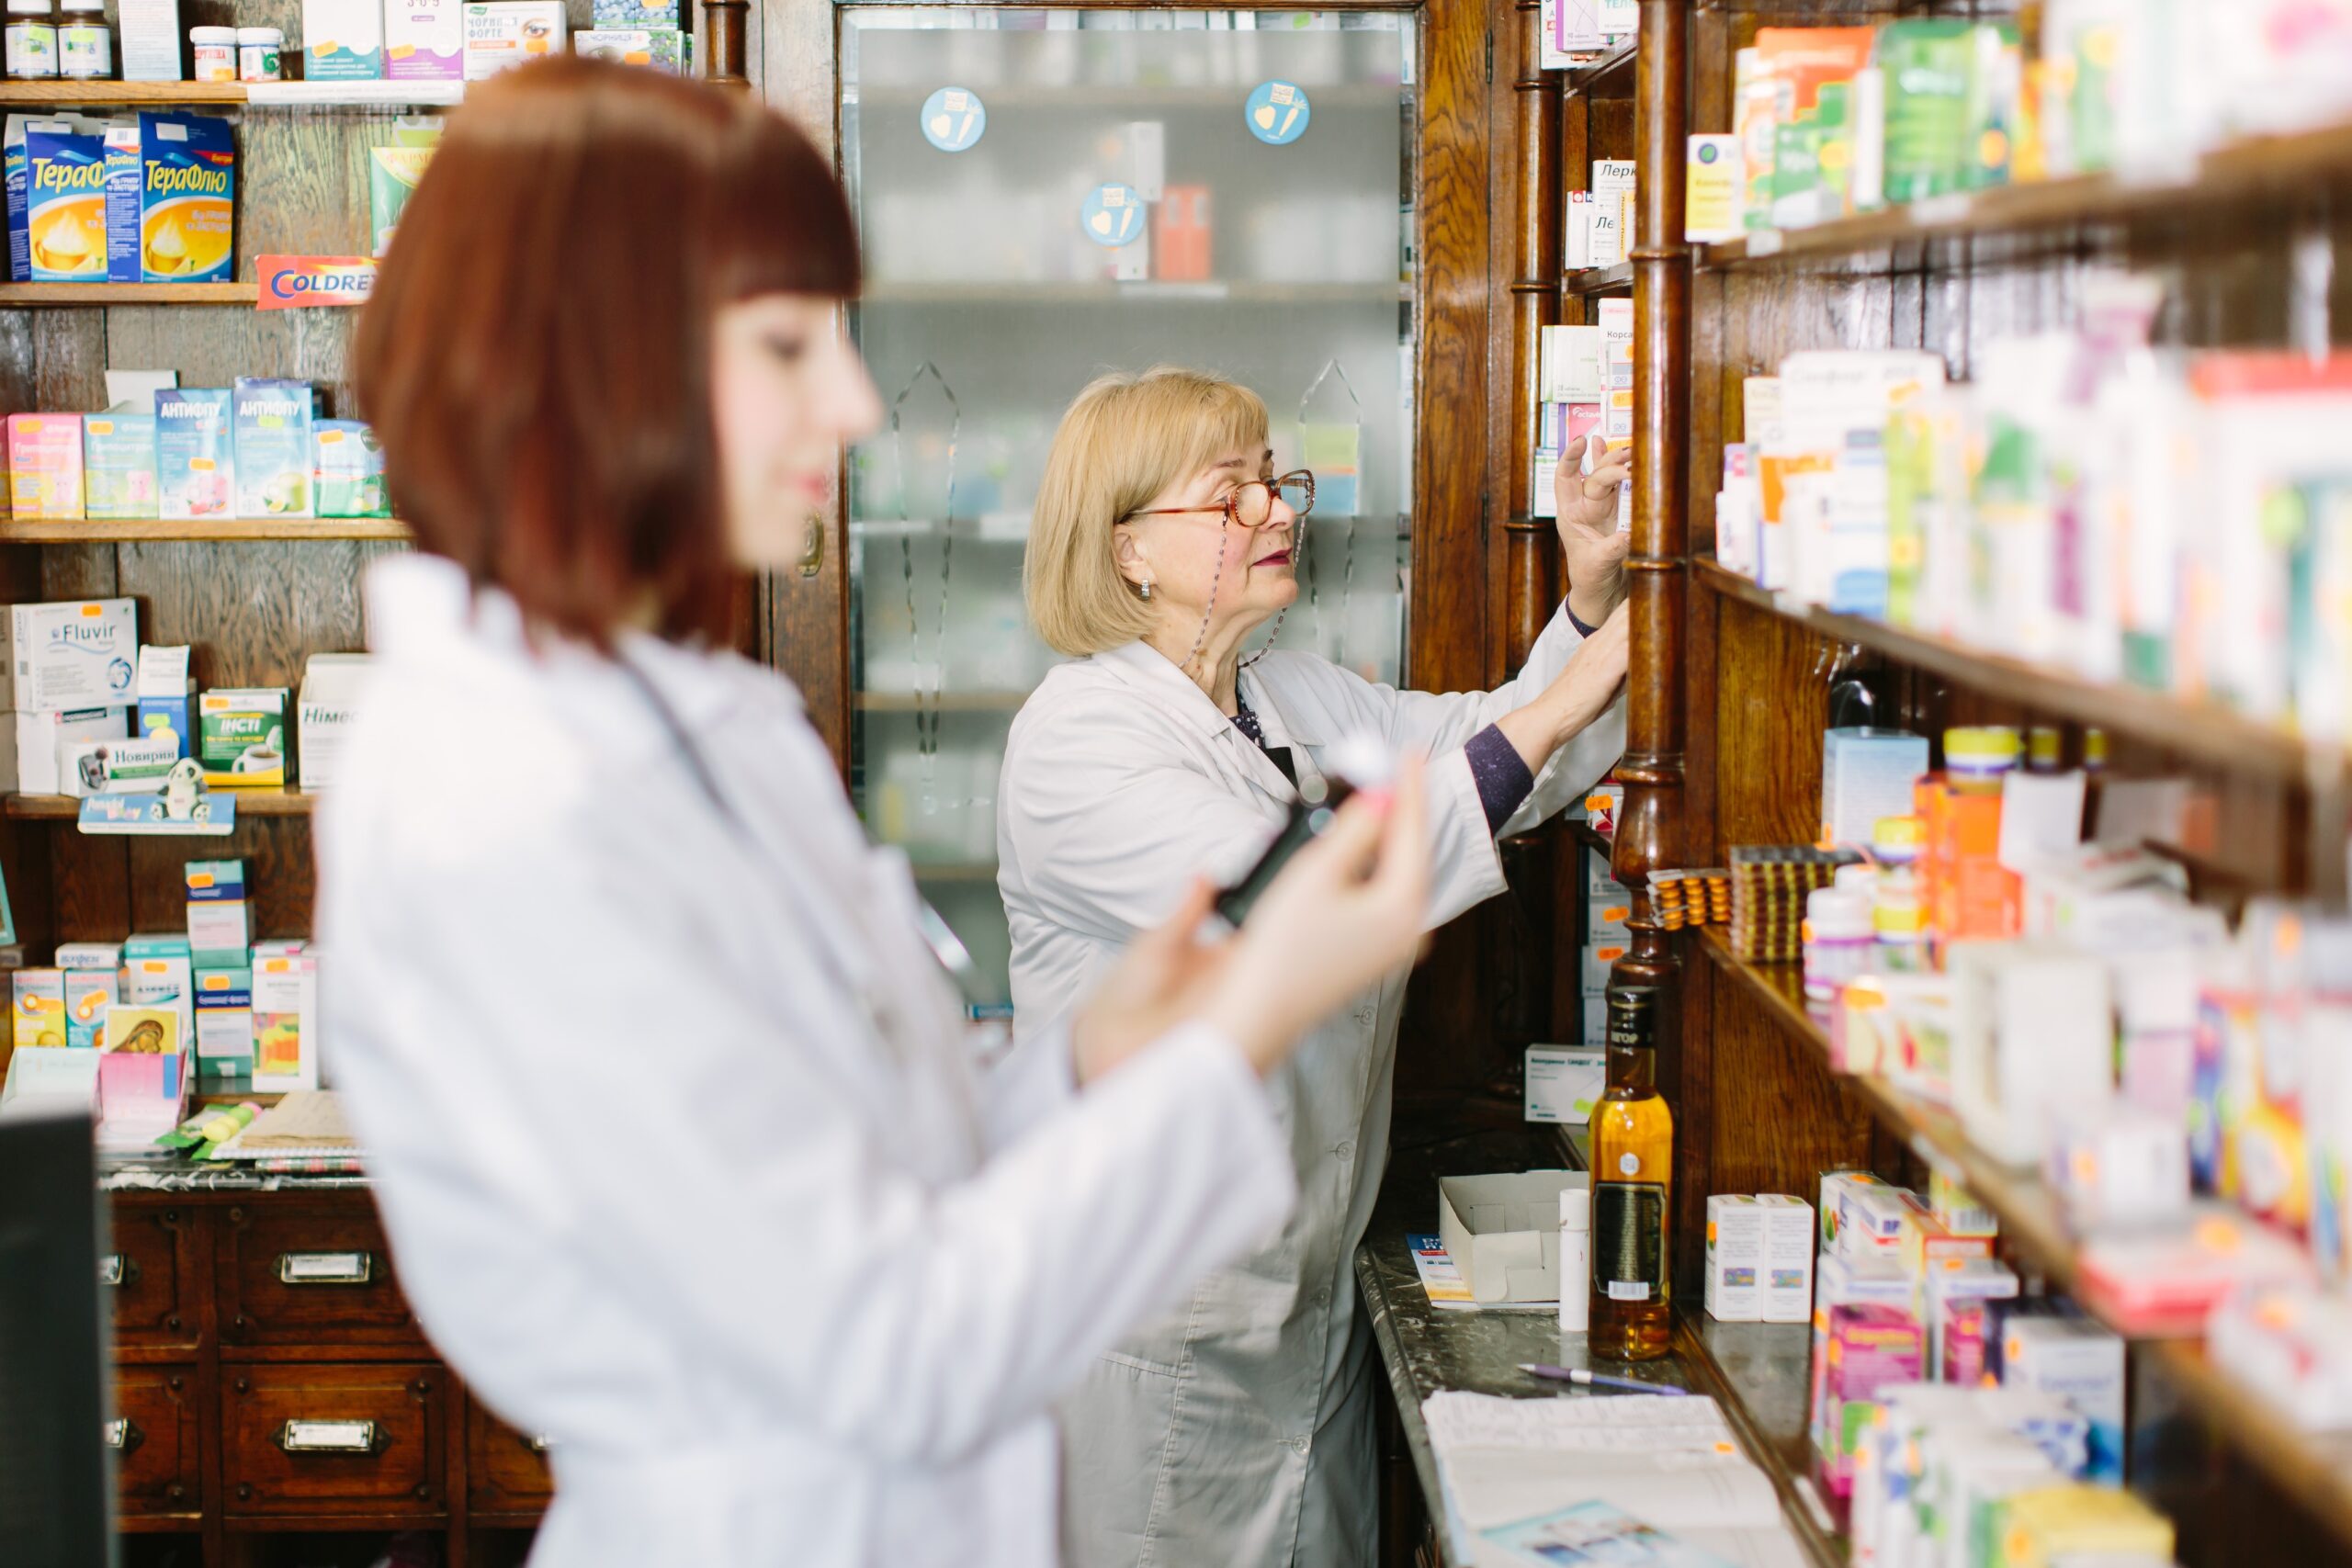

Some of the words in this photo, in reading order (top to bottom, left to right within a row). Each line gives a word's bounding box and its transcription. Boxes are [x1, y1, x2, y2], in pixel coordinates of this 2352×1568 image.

[468, 28, 503, 39] ФОРТЕ
[145, 160, 227, 196] ТераФлю
[271, 269, 375, 299] COLDRE
[62, 622, 117, 642] Fluvir
